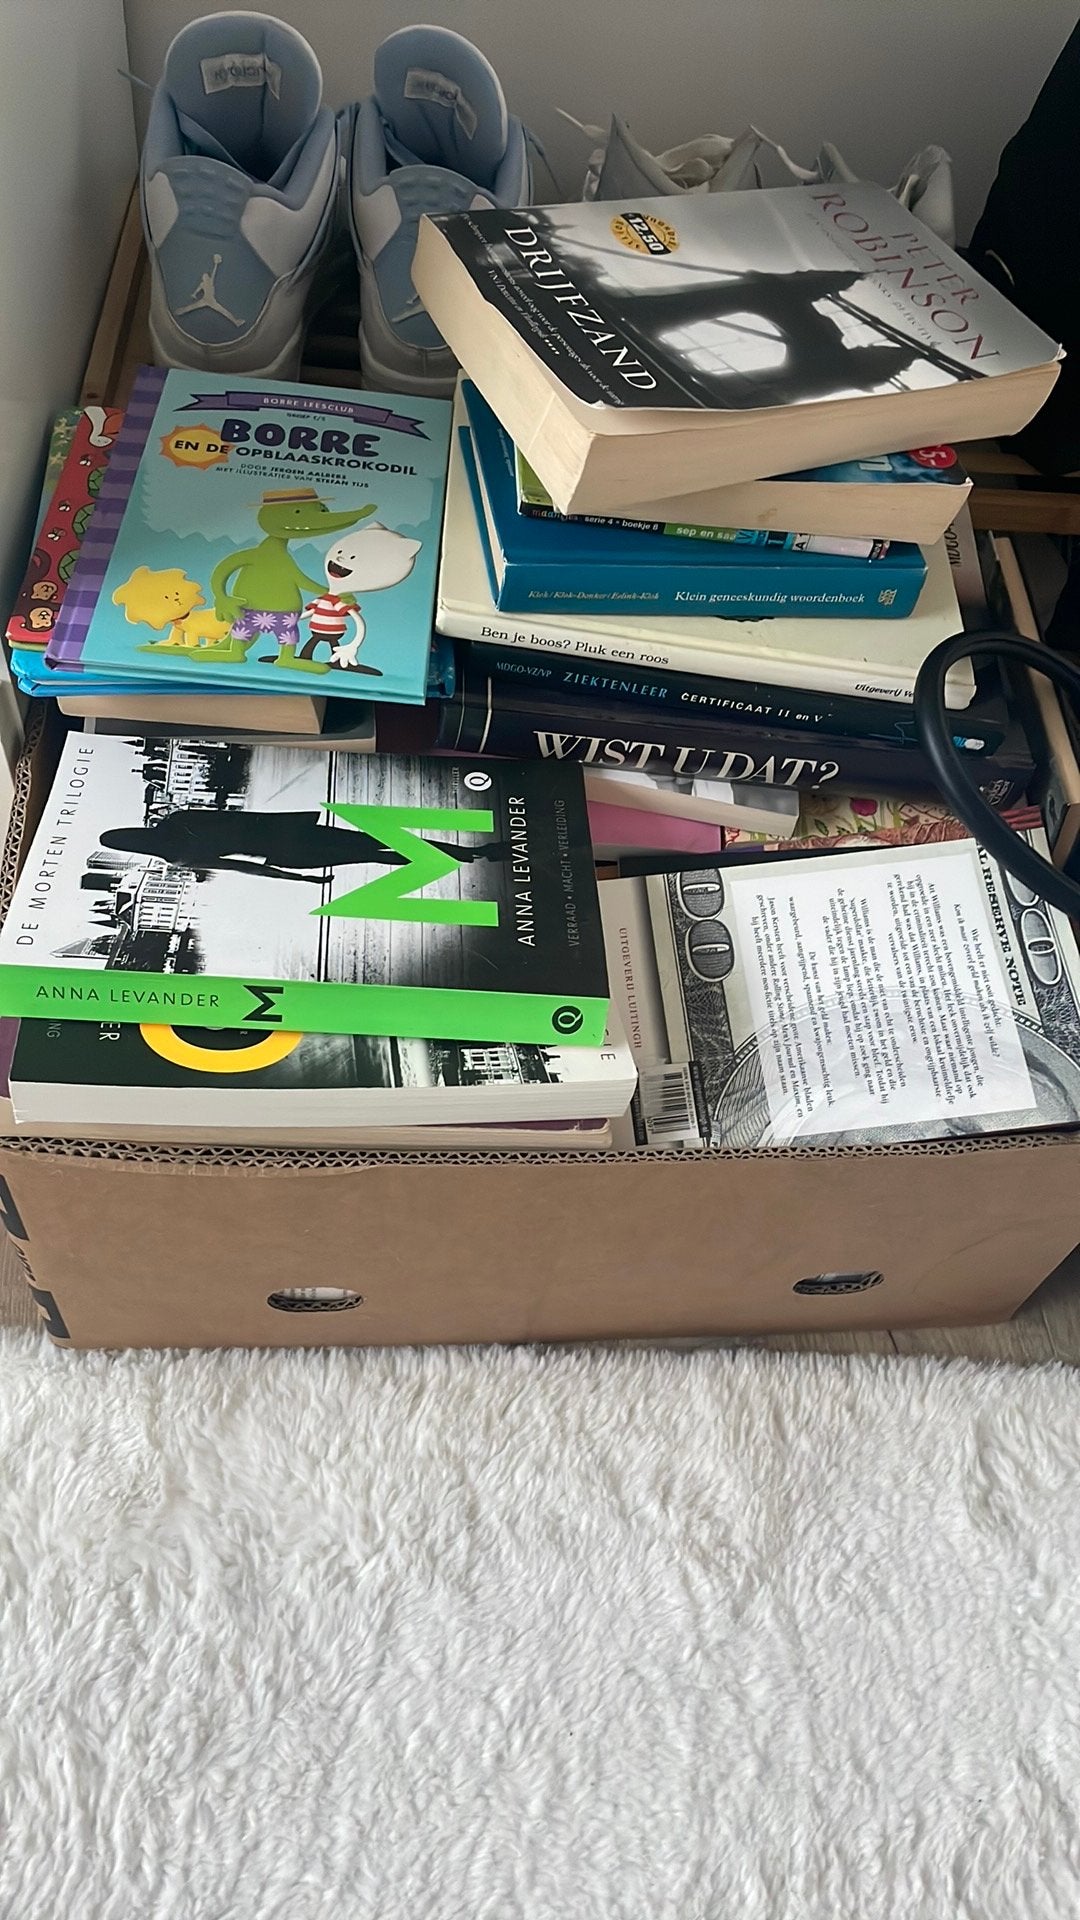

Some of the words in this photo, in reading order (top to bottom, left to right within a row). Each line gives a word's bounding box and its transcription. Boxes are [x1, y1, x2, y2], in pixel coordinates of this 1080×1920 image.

[812, 193, 1001, 360] ROBINSON
[504, 226, 657, 390] DRIJFZAND
[263, 397, 299, 406] BORRE
[303, 401, 354, 413] LEESCLUB
[220, 419, 381, 457] BORRE
[174, 440, 200, 451] EN
[206, 443, 229, 455] DE
[235, 446, 418, 476] OPBLAASKROKODIL
[235, 468, 291, 480] ILLUSTRATIES
[315, 477, 349, 486] STEFAN
[240, 463, 267, 471] DOOR
[270, 466, 305, 475] JEROEN
[584, 515, 606, 525] serie
[621, 519, 651, 531] boekje
[675, 526, 697, 537] sep
[700, 530, 714, 538] en
[717, 531, 737, 541] saa
[675, 591, 707, 601] Klein
[708, 591, 787, 604] geneeskundig
[790, 592, 865, 603] woordenboek
[481, 627, 508, 640] Ben
[511, 631, 526, 644] je
[530, 634, 571, 649] boos?
[575, 641, 607, 656] Pluk
[611, 648, 635, 660] een
[639, 654, 669, 665] roos
[563, 671, 669, 699] ZIEKTENLEER
[681, 692, 772, 715] CERTIFICAAT
[795, 713, 809, 722] en
[532, 730, 665, 770] WIST
[672, 746, 716, 776] U
[714, 751, 840, 790] DAT?
[553, 799, 570, 853] VERLEIDING
[16, 922, 39, 946] DE
[28, 835, 69, 910] MORTEN
[56, 747, 94, 826] TRILOGIE
[508, 796, 531, 883] LEVANDER
[309, 802, 500, 928] M
[560, 859, 574, 894] MACHT
[905, 880, 915, 890] hij
[893, 873, 907, 902] gerekend
[913, 874, 929, 906] opgroeide
[928, 883, 937, 893] Art
[517, 890, 536, 947] ANNA
[901, 903, 910, 916] had
[930, 894, 944, 923] Williams
[953, 903, 963, 916] Kon
[564, 903, 580, 948] VERRAAD
[904, 917, 912, 930] was
[913, 908, 929, 948] criminaliteit
[959, 925, 967, 941] maar
[908, 931, 917, 942] dat
[928, 928, 936, 942] zeer
[941, 938, 949, 950] een
[970, 928, 980, 941] Wie
[982, 868, 1012, 953] RESERVE
[1005, 956, 1027, 1006] NOTE
[923, 949, 935, 972] terecht
[932, 944, 943, 963] slecht
[963, 943, 975, 963] zoveel
[973, 943, 985, 959] heeft
[887, 932, 901, 965] vervalsers
[899, 989, 914, 1023] twintigste
[928, 974, 936, 986] zou
[943, 951, 964, 1005] bovengemiddeld
[967, 964, 979, 978] geld
[980, 969, 991, 983] niet
[619, 927, 634, 991] UITGEVERIJ
[628, 994, 642, 1049] LUITINGH
[919, 984, 932, 1005] plaats
[943, 988, 952, 1001] Het
[973, 979, 985, 1001] maken
[984, 984, 995, 998] ooit
[36, 985, 100, 1001] ANNA
[110, 988, 219, 1008] LEVANDER
[241, 984, 285, 1023] M
[893, 917, 909, 950] uitgroeide
[902, 951, 911, 961] tot
[913, 999, 928, 1034] beruchtste
[923, 1046, 943, 1097] ongrijpbaarste
[925, 1006, 933, 1018] van
[947, 1003, 956, 1017] leek
[978, 1002, 987, 1012] als
[938, 1013, 949, 1032] Maar
[957, 1006, 974, 1046] intelligente
[983, 1021, 993, 1034] zelf
[932, 1033, 944, 1055] lokaal
[943, 1033, 951, 1050] waar
[949, 1018, 969, 1070] onvermijdelijk
[947, 1051, 962, 1082] niemand
[963, 1070, 972, 1082] dat
[936, 1056, 956, 1104] kruimeldiefje
[975, 1074, 985, 1087] die
[966, 1083, 976, 1099] ook
